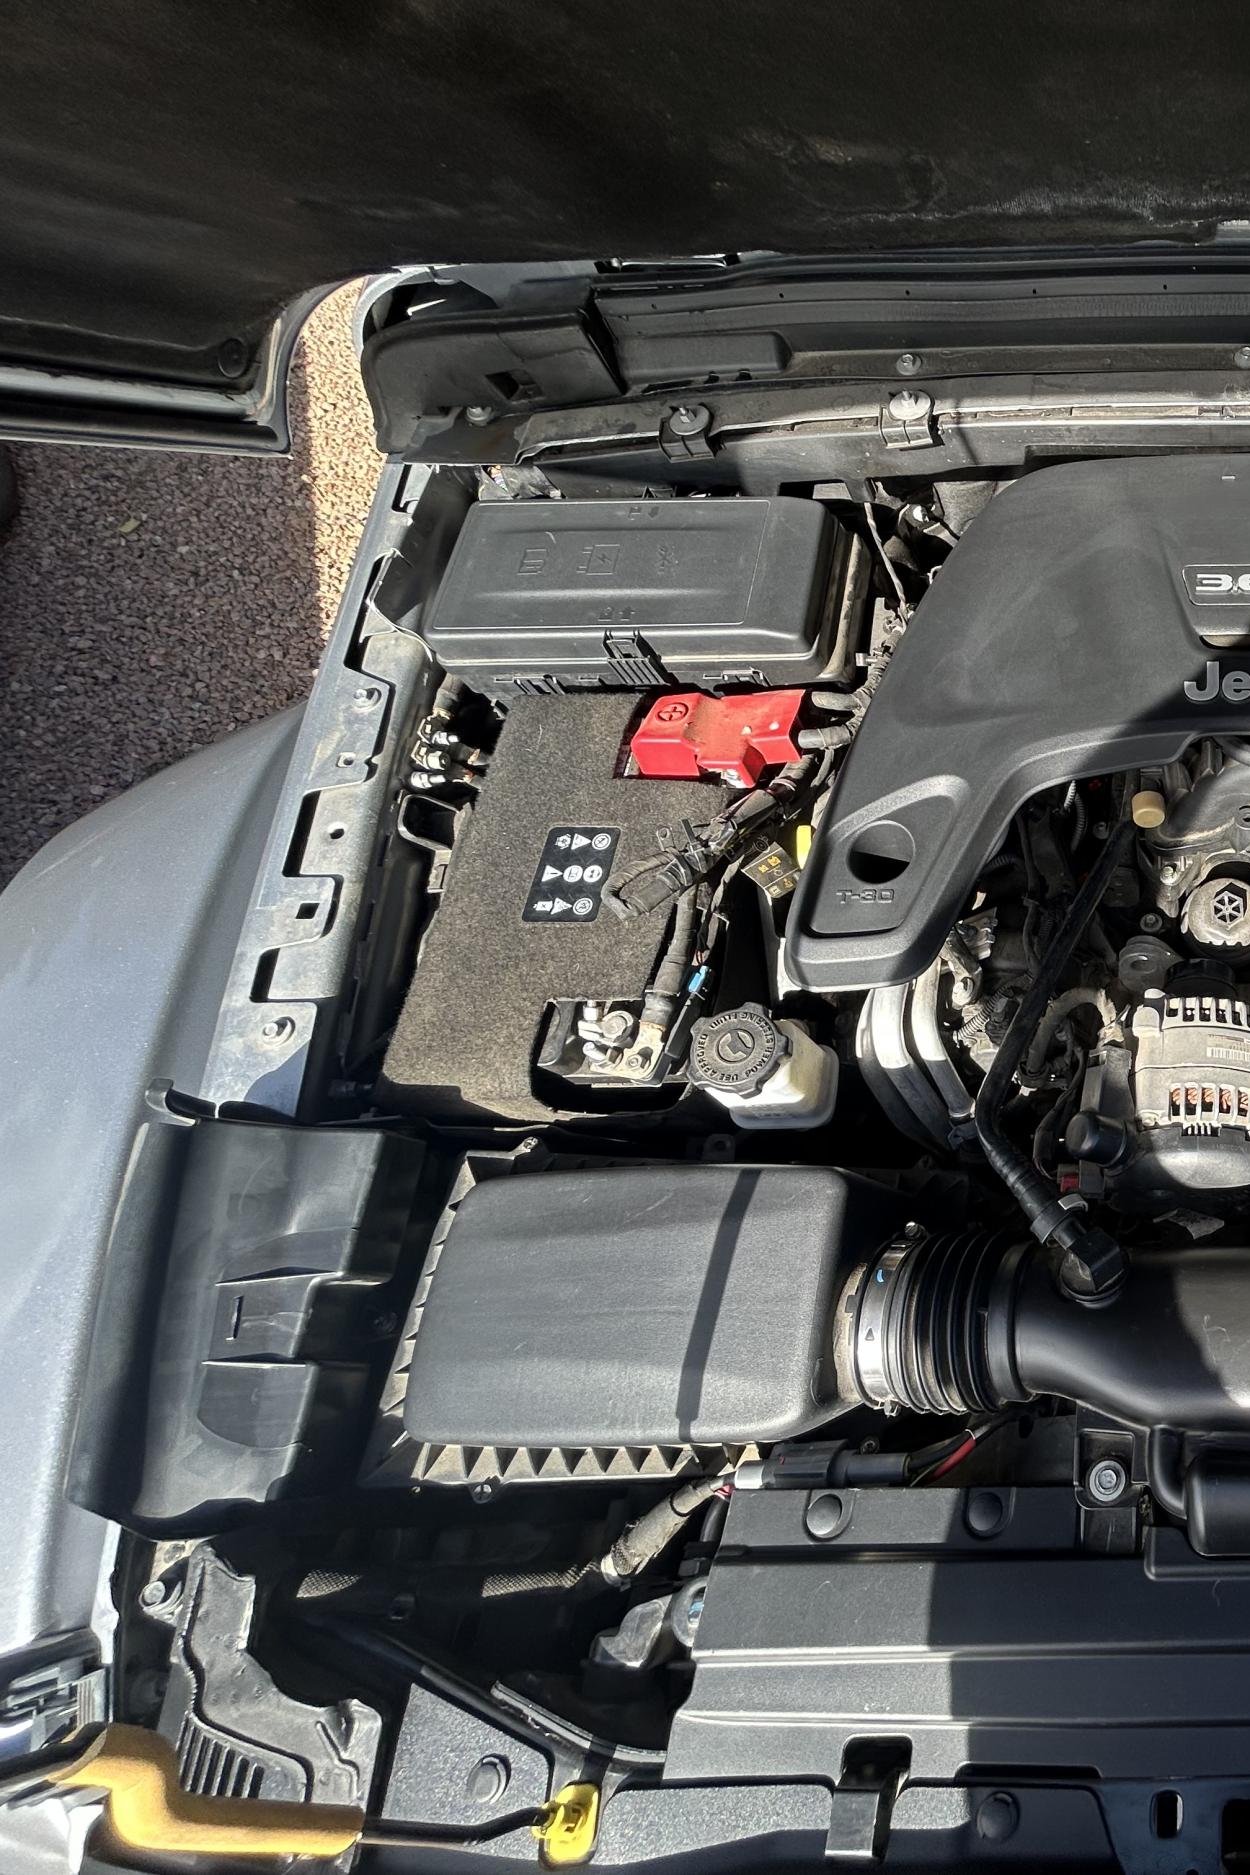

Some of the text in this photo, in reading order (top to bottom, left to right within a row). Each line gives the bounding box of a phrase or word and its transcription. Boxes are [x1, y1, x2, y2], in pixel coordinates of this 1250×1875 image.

[836, 888, 895, 904] T-30
[740, 1011, 774, 1045] STEERING
[696, 1033, 718, 1078] APPROVED
[744, 1045, 774, 1078] POWER
